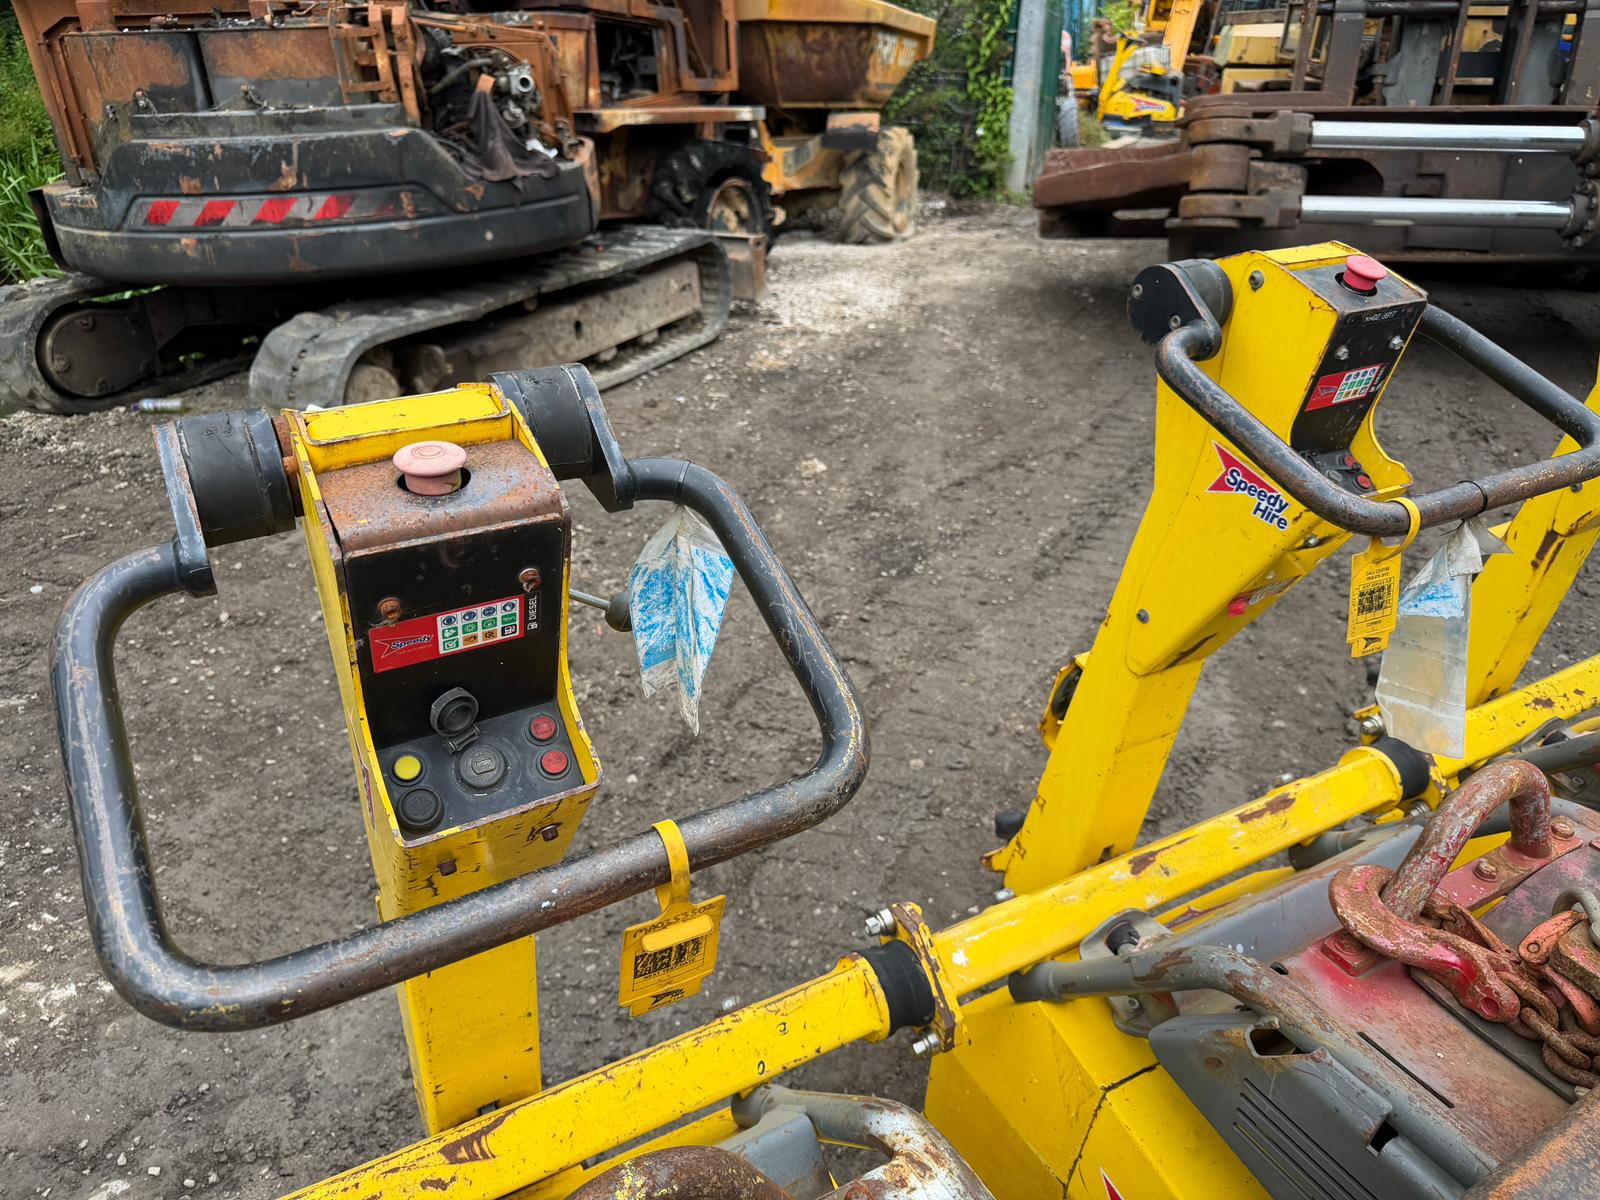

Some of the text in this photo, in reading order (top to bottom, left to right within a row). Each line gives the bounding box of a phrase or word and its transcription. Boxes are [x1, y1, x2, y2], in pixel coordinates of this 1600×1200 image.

[1226, 468, 1289, 513] Speedy
[1252, 502, 1288, 530] Hire
[528, 594, 538, 621] DIESEL
[390, 634, 434, 650] Speedy
